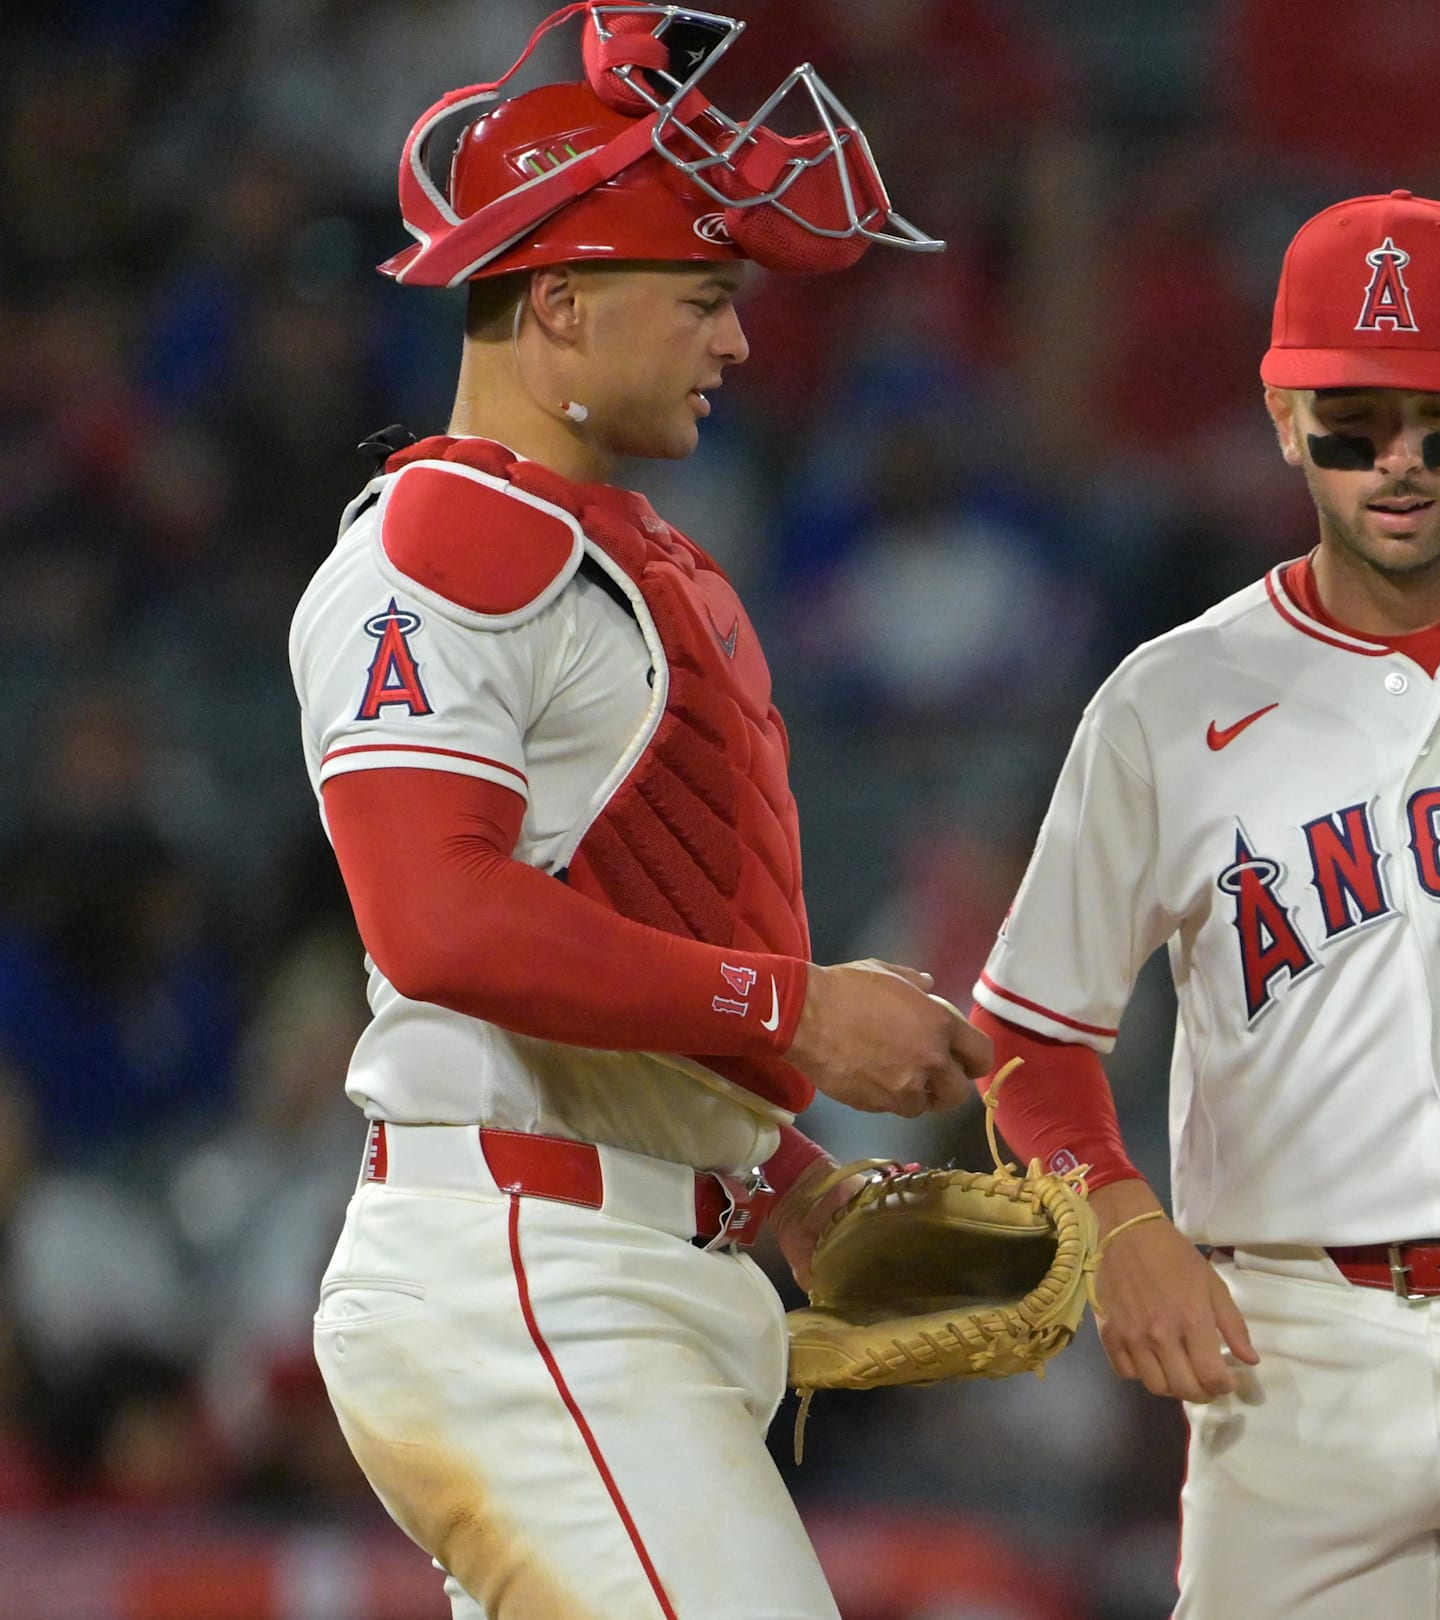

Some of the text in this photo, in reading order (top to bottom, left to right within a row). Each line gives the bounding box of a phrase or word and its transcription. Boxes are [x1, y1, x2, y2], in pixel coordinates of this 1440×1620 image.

[1354, 237, 1420, 332] A
[355, 597, 435, 722] A
[712, 961, 757, 1018] 14
